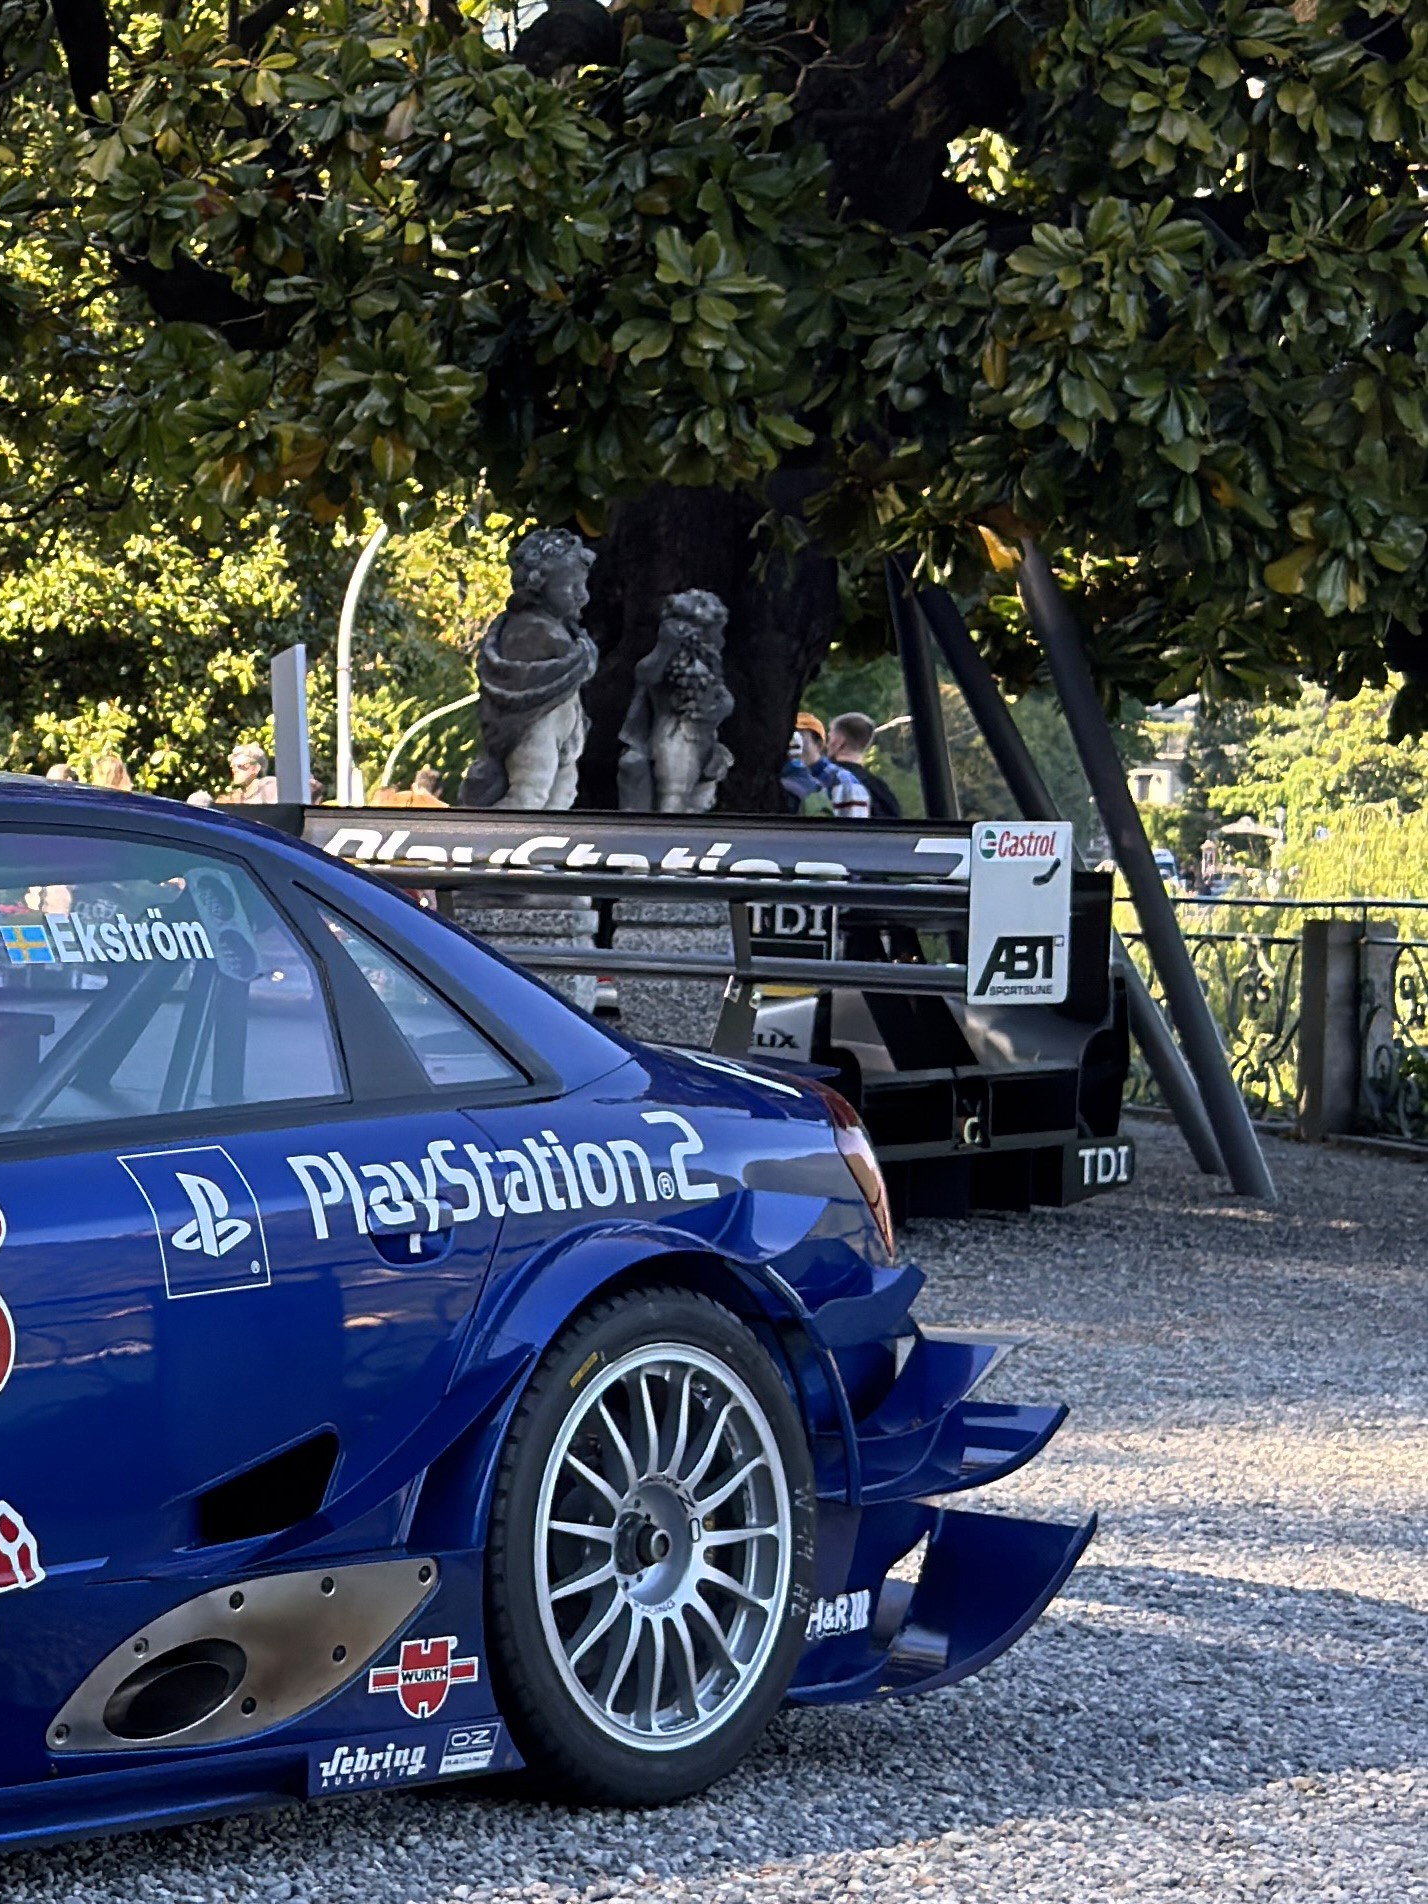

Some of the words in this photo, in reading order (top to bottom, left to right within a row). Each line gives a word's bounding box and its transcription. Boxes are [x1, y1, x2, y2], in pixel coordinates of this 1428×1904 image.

[997, 830, 1057, 858] Castrol
[45, 908, 215, 963] Ekström
[746, 903, 828, 936] TDI
[973, 936, 1054, 996] ABT
[989, 985, 1053, 996] SPORTSLINE
[1078, 1146, 1129, 1186] TDI
[804, 1594, 851, 1641] H&R
[319, 1743, 427, 1777] Sebring
